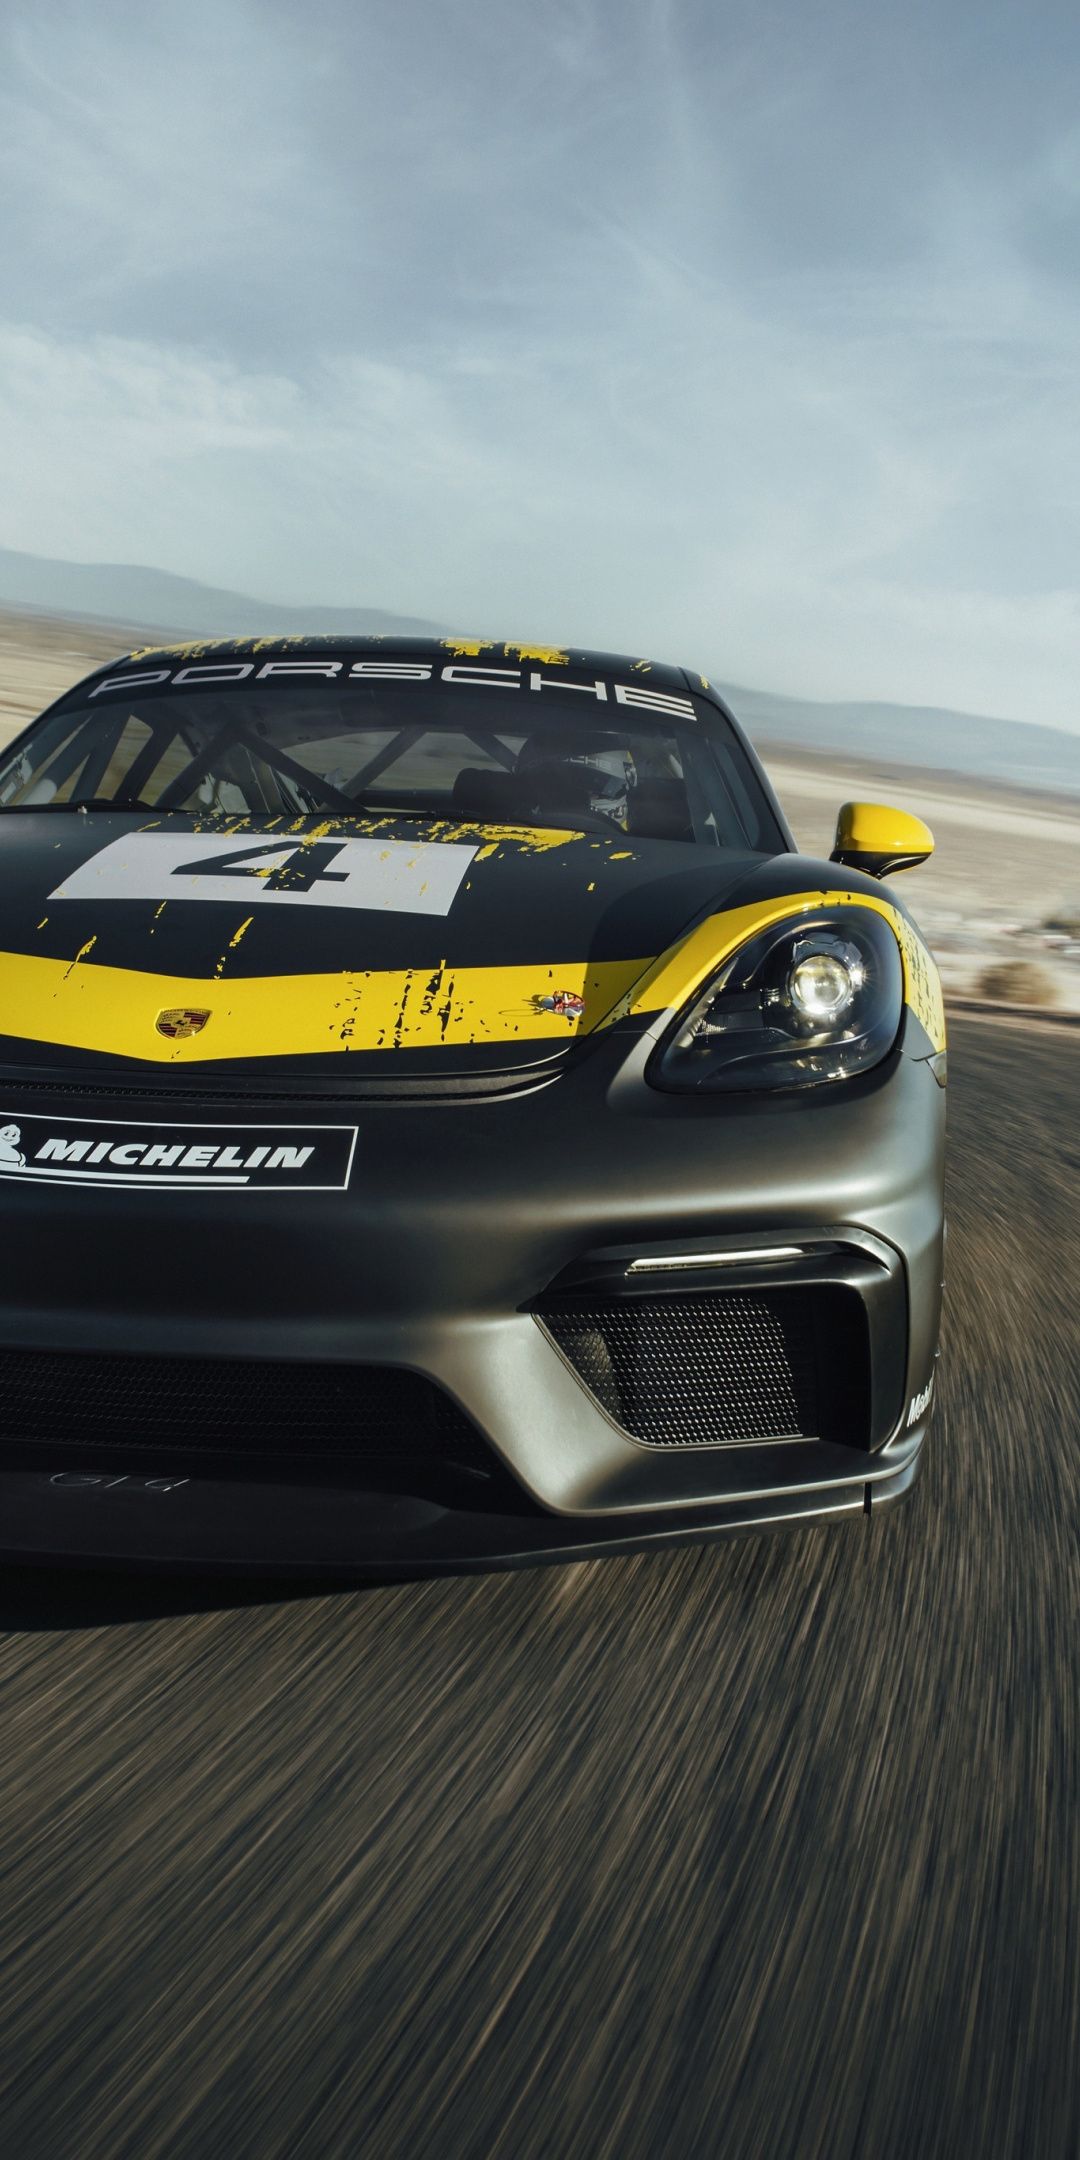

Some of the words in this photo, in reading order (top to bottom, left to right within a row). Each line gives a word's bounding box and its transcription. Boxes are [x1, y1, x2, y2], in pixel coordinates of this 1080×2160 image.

[88, 660, 698, 722] PORSCHE
[171, 839, 351, 892] 4
[35, 1138, 316, 1168] MICHELIN
